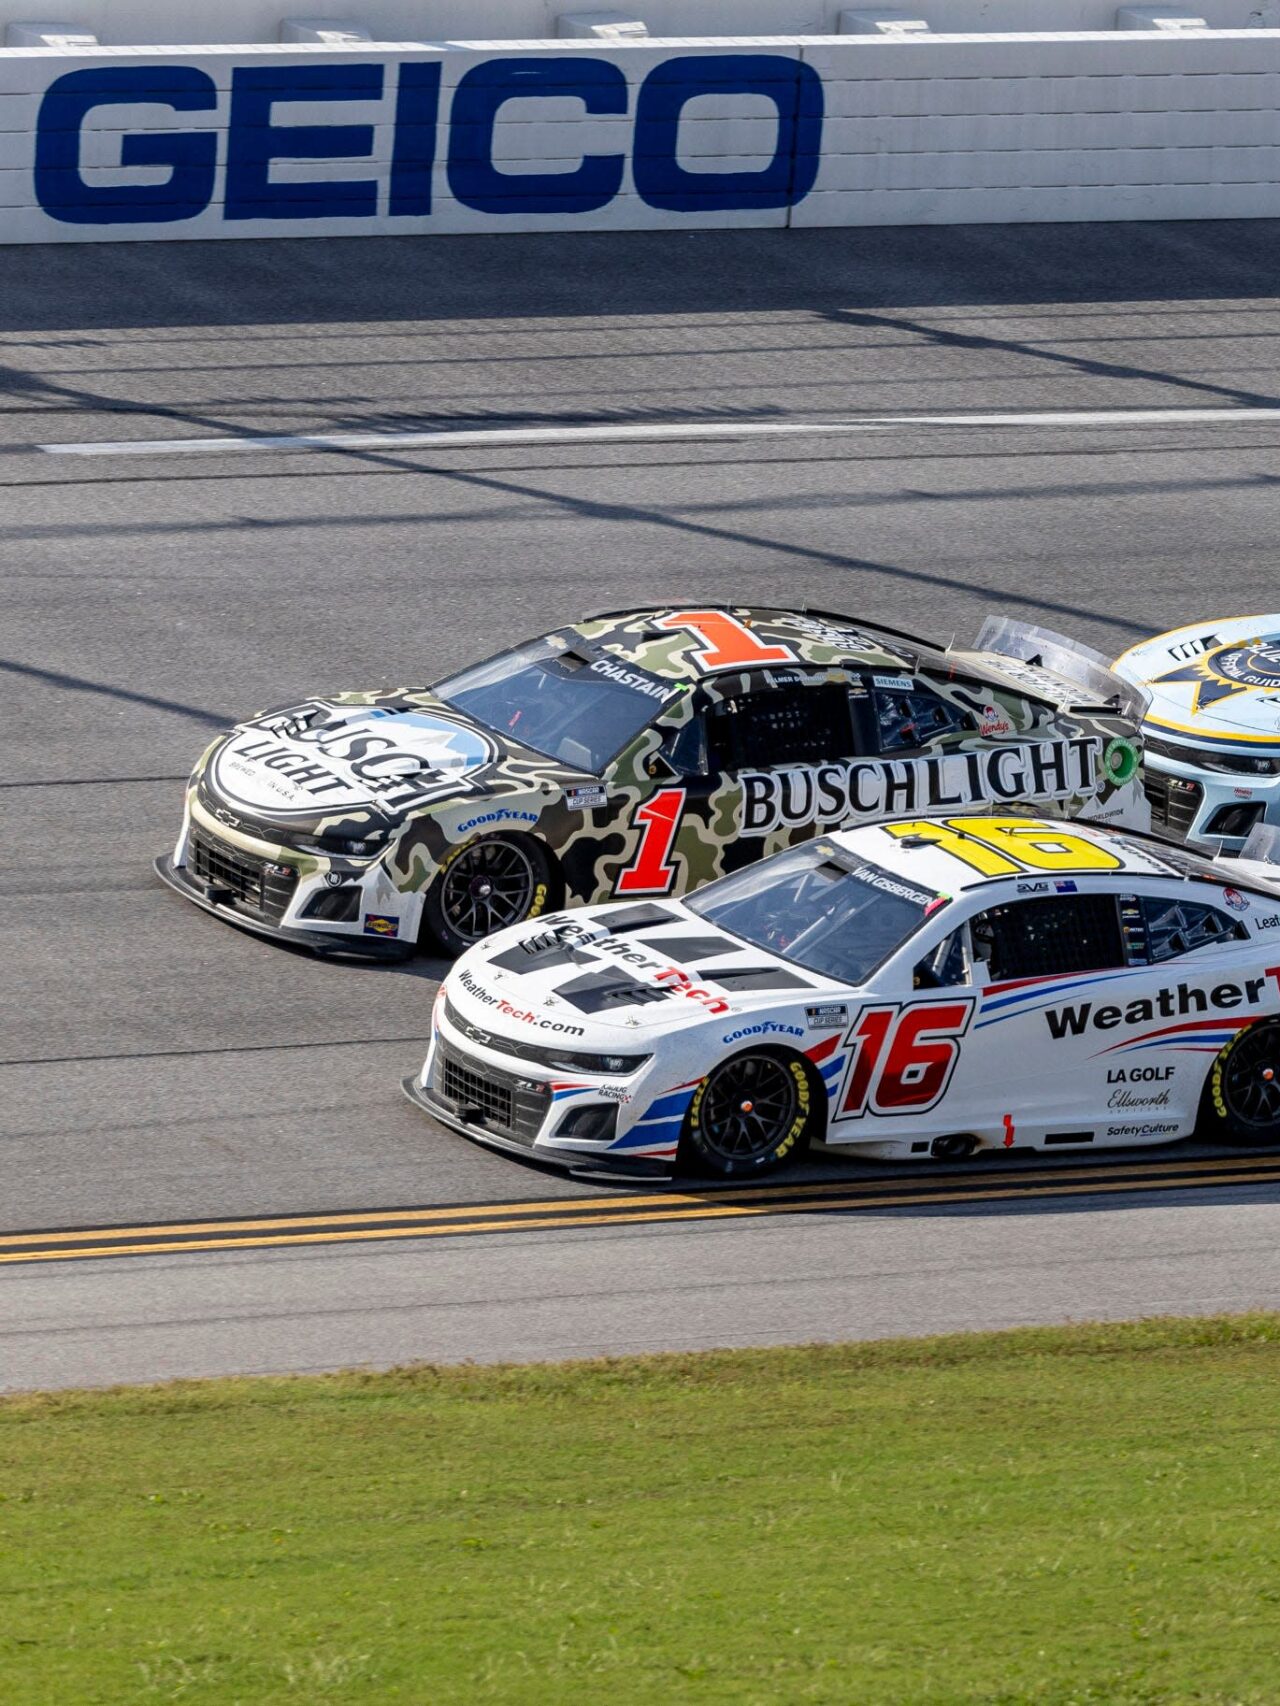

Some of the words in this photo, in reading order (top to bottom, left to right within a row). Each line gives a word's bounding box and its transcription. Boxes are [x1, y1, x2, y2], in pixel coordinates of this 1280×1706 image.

[34, 55, 824, 225] GEICO
[653, 608, 800, 672] 1
[590, 659, 679, 704] CHASTAIN
[875, 677, 912, 688] SIEMENS
[979, 721, 1010, 737] Wendy's
[234, 740, 355, 796] LIGHT
[741, 758, 921, 832] BUSCH
[926, 735, 1100, 807] LIGHT
[573, 796, 584, 805] CUP
[585, 796, 602, 805] SERIES
[457, 808, 539, 833] GOODYEAR
[1088, 808, 1124, 822] WORLDWIDE
[612, 787, 687, 897] 1
[882, 817, 1126, 877] 16
[852, 865, 877, 885] VAN
[875, 876, 933, 906] GISBERGEN
[1017, 882, 1049, 892] SVG
[366, 919, 399, 932] SUNOCO
[458, 968, 585, 1037] WeatherTech.com
[814, 1017, 825, 1025] CUP
[827, 1016, 843, 1025] SERIES
[722, 1021, 805, 1044] GOODYEAR
[832, 996, 977, 1123] 16
[1107, 1069, 1127, 1083] LA
[1130, 1066, 1176, 1081] GOLF
[598, 1089, 625, 1100] RACING
[1107, 1088, 1171, 1109] Ellsworth
[1107, 1123, 1179, 1137] SafetyCulture
